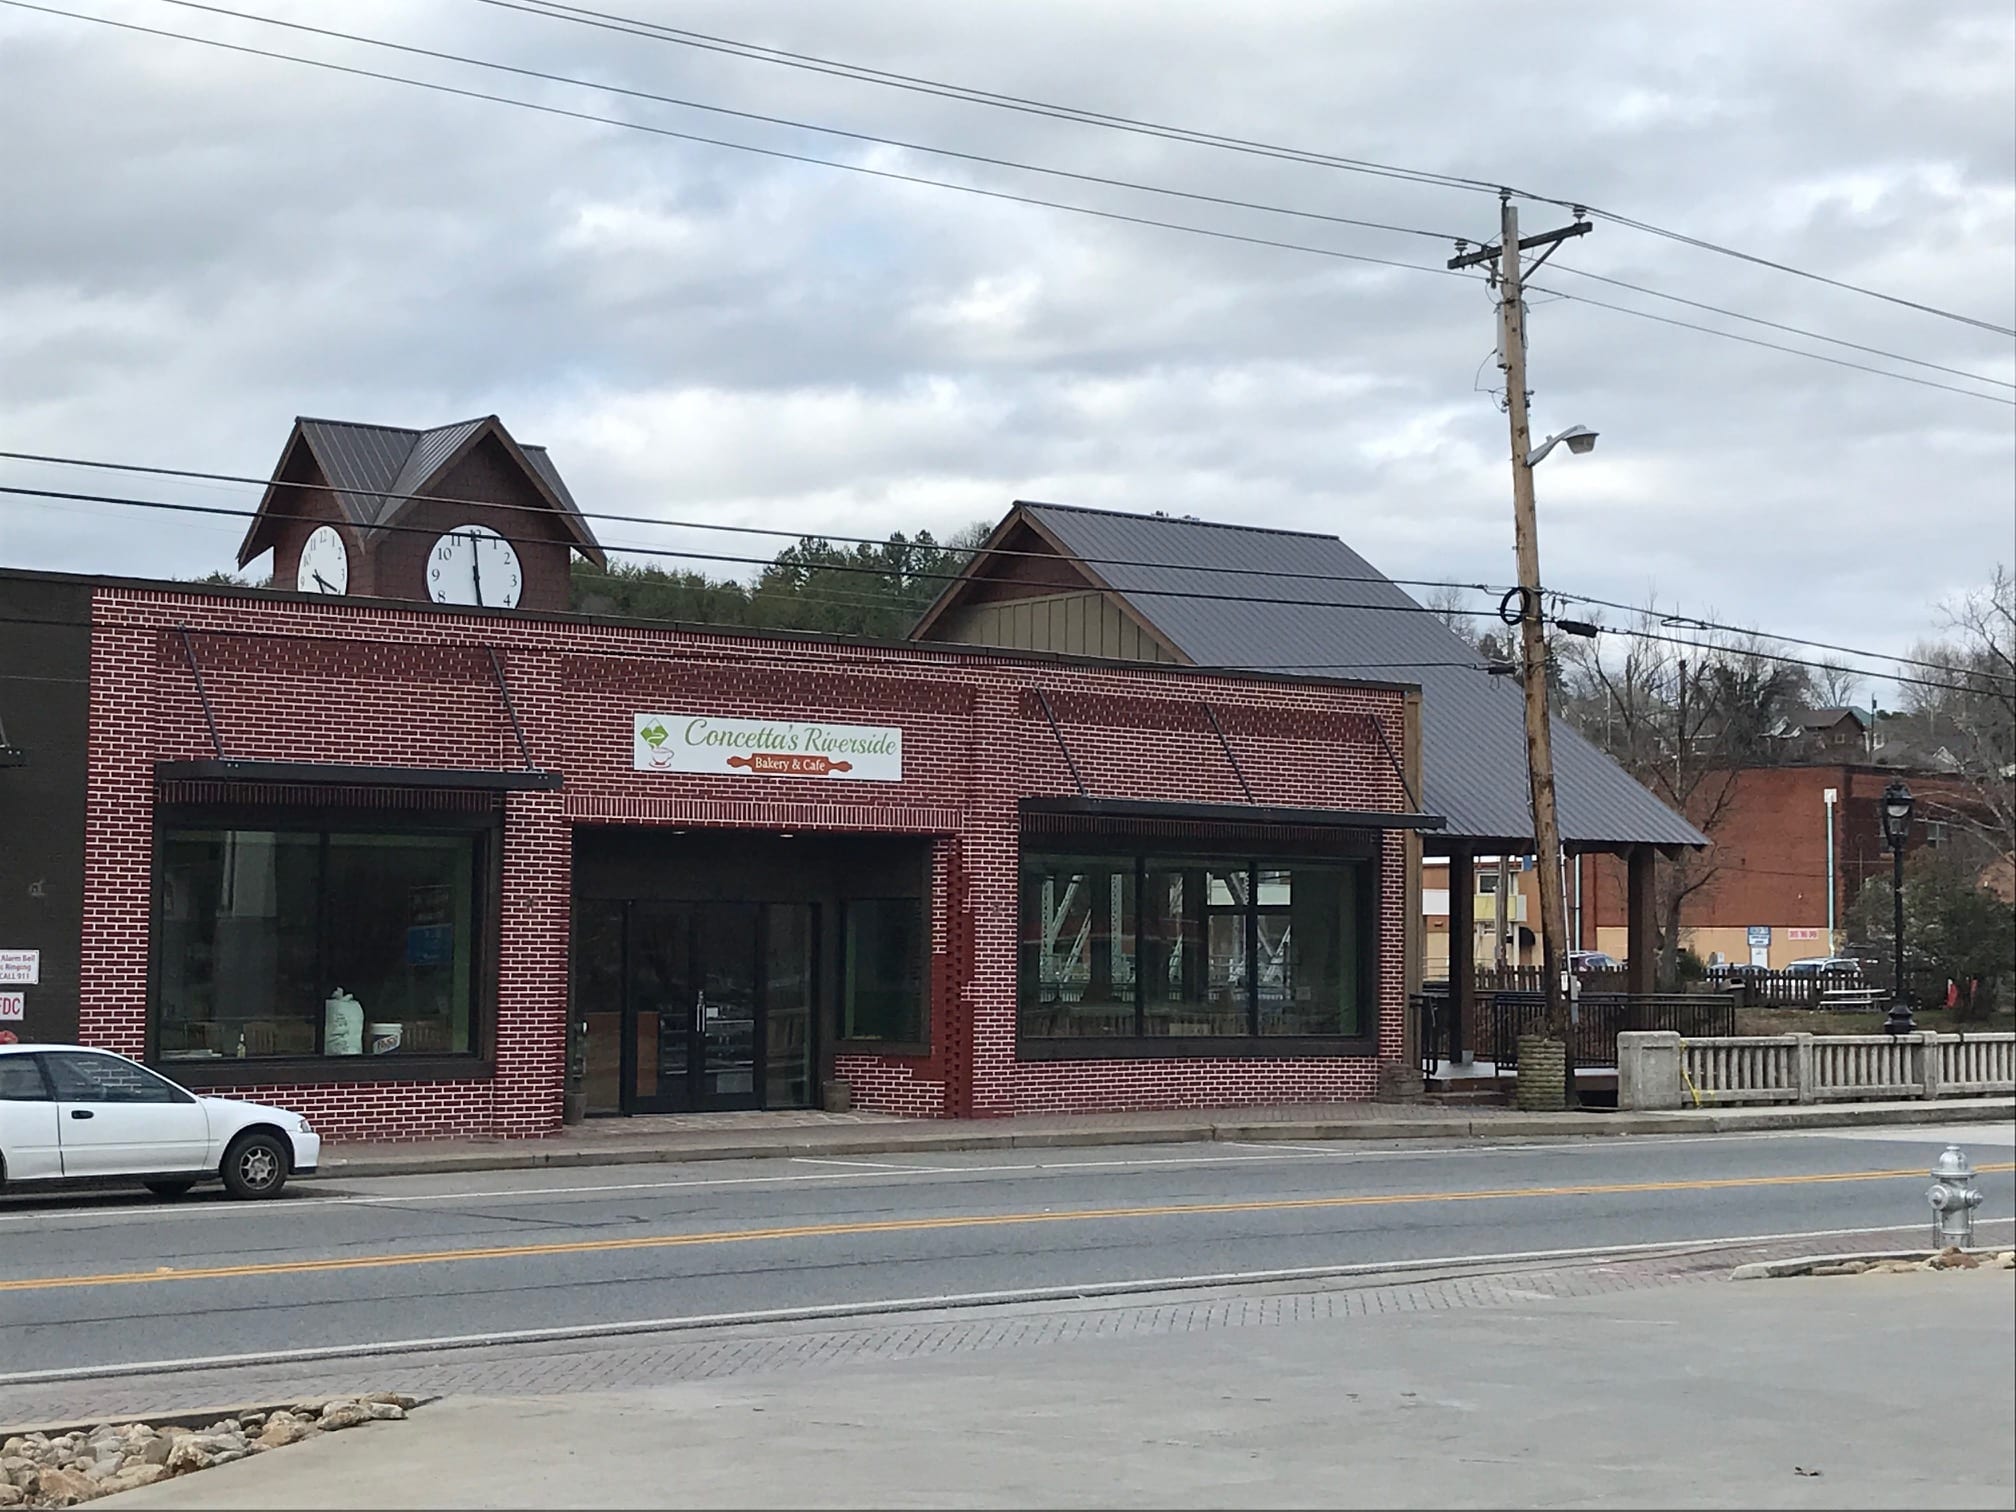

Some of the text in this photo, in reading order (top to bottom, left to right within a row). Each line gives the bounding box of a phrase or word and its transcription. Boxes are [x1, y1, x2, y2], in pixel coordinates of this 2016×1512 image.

[450, 534, 462, 547] 11
[438, 547, 452, 561] 10
[504, 552, 511, 566] 2
[432, 568, 440, 582] 9
[510, 574, 518, 588] 3
[438, 590, 446, 603] 8
[503, 594, 512, 607] 4
[684, 718, 898, 756] Concetta's Riverside
[755, 756, 826, 772] Bakery & Cafe
